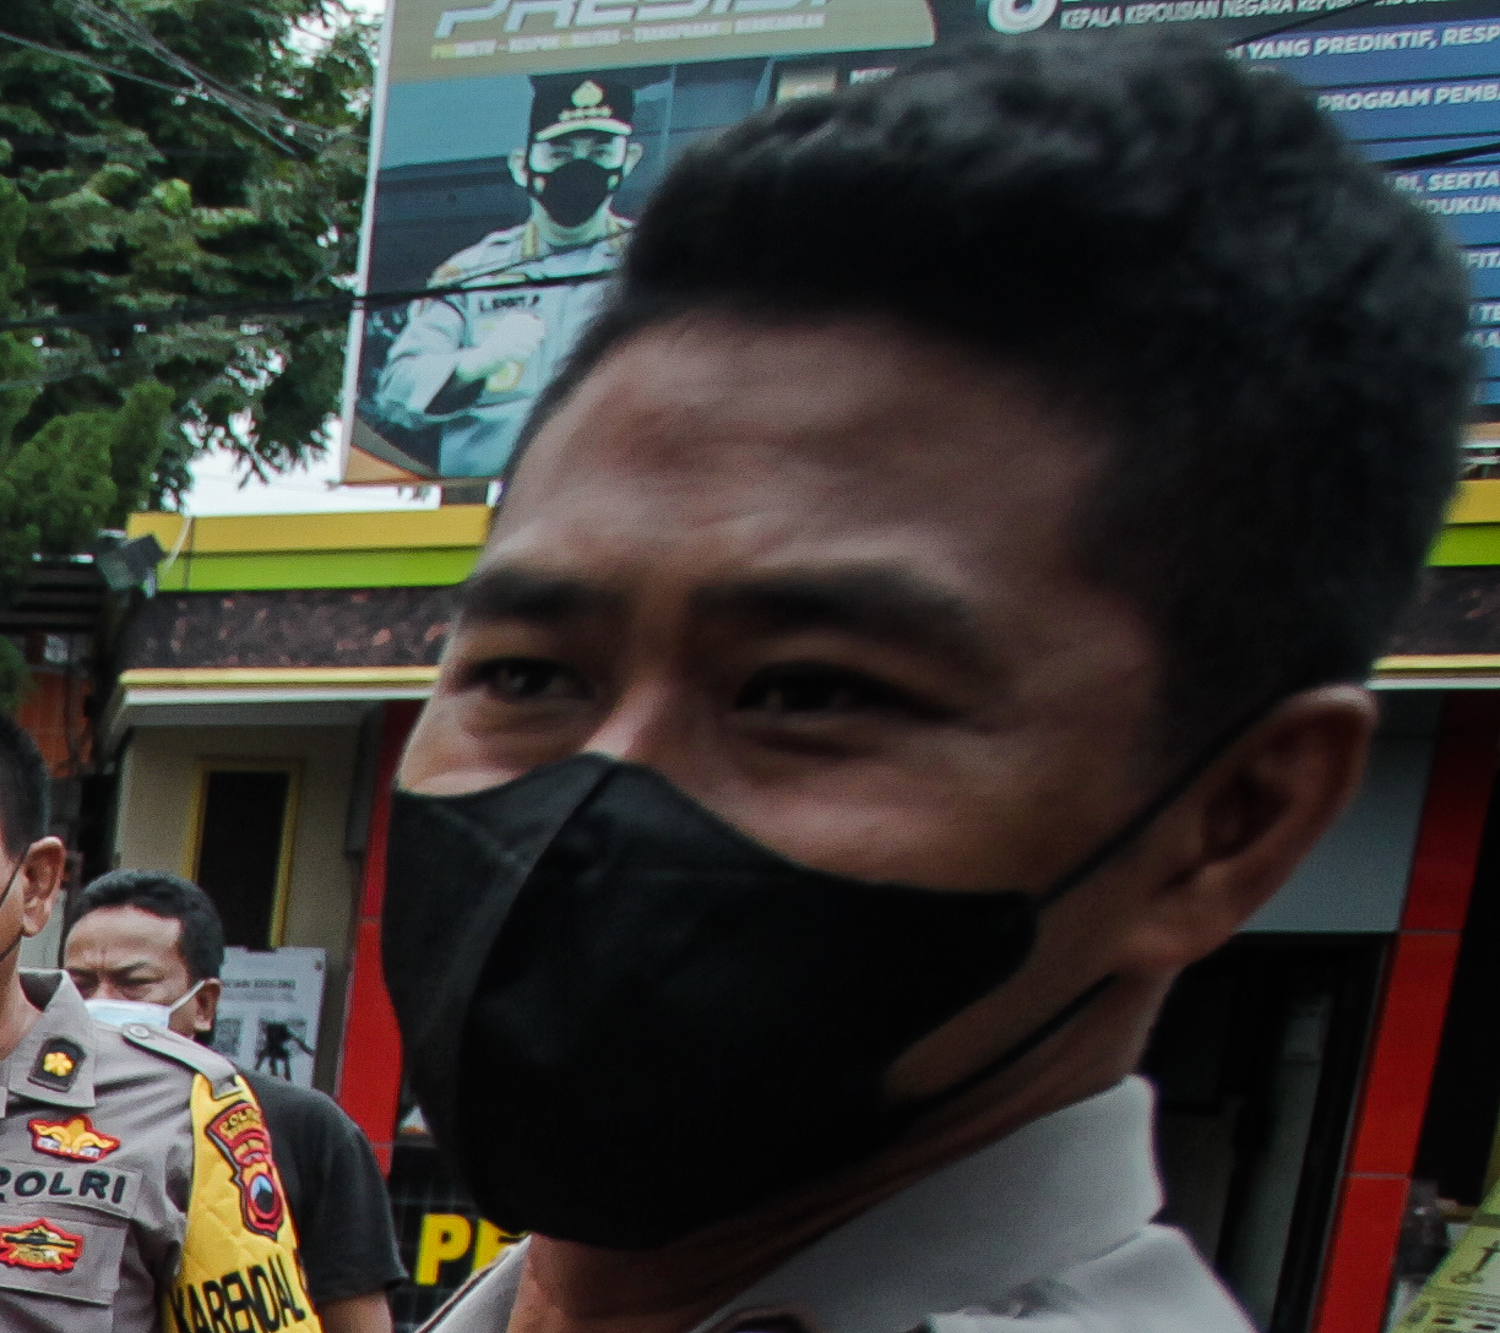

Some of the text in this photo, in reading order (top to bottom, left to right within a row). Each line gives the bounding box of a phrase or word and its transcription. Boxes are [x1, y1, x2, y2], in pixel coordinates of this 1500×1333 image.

[1060, 7, 1121, 30] KEPALA
[1123, 2, 1220, 27] KEPOLISIAN
[1248, 38, 1311, 60] YANG
[1313, 29, 1440, 56] PREDIKTIF,
[1316, 84, 1500, 111] PROGRAM PEMB
[1426, 170, 1500, 192] SERTA
